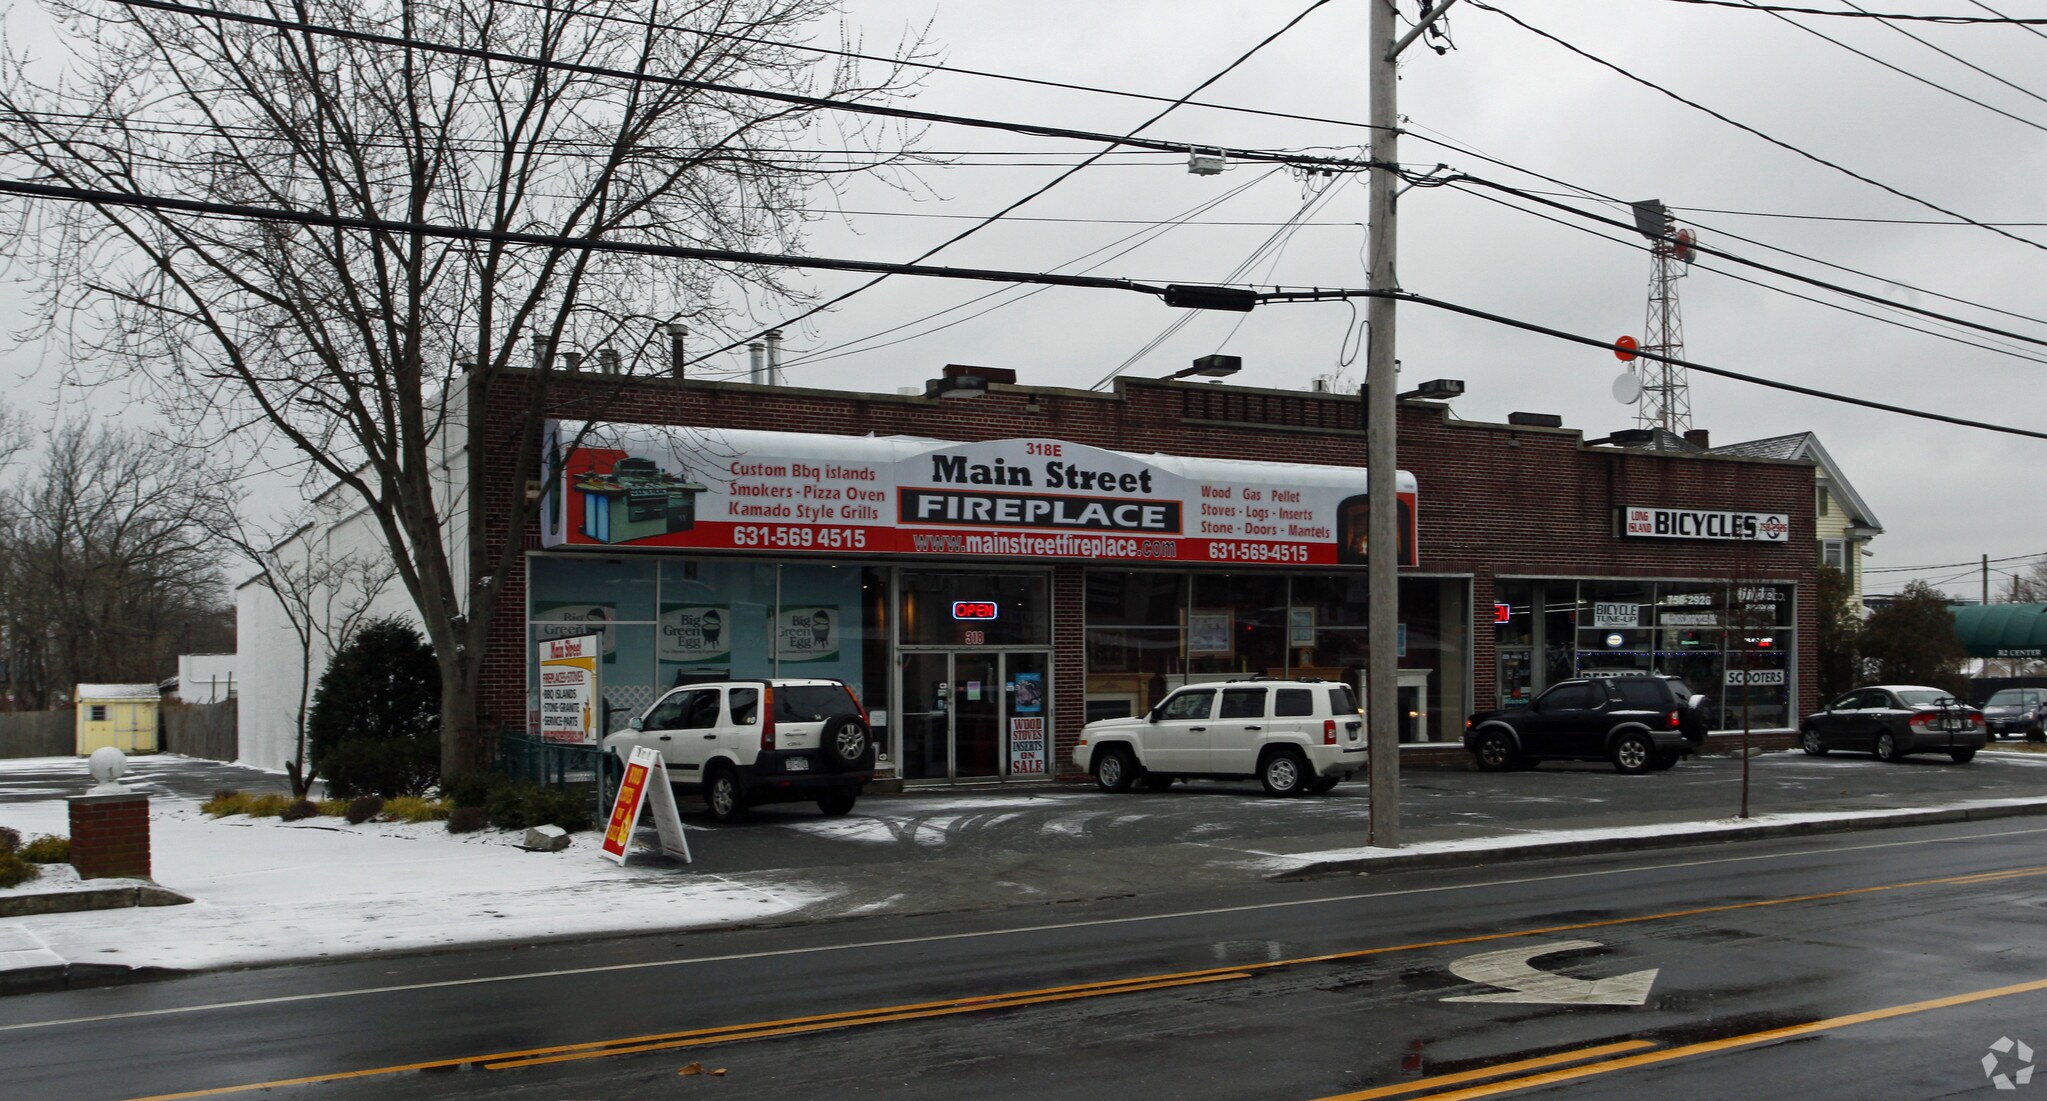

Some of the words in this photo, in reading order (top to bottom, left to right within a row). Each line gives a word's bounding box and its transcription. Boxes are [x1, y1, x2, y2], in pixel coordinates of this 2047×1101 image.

[1026, 442, 1062, 457] 318E
[730, 461, 787, 477] Custom
[792, 463, 820, 482] Bbq
[826, 464, 876, 481] islands
[932, 454, 1032, 486] Main
[1046, 461, 1152, 493] Street
[730, 481, 793, 498] Smokers
[803, 485, 841, 500] Pizza
[846, 487, 885, 502] Oven
[1201, 485, 1231, 499] Wood
[1243, 488, 1262, 501] Gas
[1271, 489, 1301, 503] Pellet
[729, 501, 791, 518] Kamado
[796, 504, 834, 522] Style
[841, 505, 879, 520] Grills
[917, 494, 1166, 529] FIREPLACE
[1201, 503, 1236, 517] Stoves
[1246, 505, 1269, 521] Logs
[1279, 507, 1313, 521] Inserts
[1631, 510, 1649, 522] LONG
[1201, 520, 1233, 534] Stone
[1244, 522, 1277, 535] Doors
[1288, 524, 1331, 539] Mantels
[1628, 522, 1652, 534] ISLAND
[1655, 511, 1757, 538] BICYCLES
[733, 525, 813, 547] 631-569
[817, 528, 866, 548] 4515
[913, 531, 1177, 559] www.mainstreetfireplace.com
[1209, 542, 1308, 562] 631-569-4515
[955, 603, 995, 617] OPEN
[1596, 604, 1637, 616] BICYCLE
[681, 614, 701, 628] Big
[792, 615, 811, 628] Big
[1596, 615, 1637, 623] TUNE-UP
[663, 625, 701, 636] Green
[965, 631, 984, 644] 318
[678, 636, 701, 650] Egg
[790, 636, 811, 649] Egg
[2009, 649, 2042, 657] CENTER
[1728, 671, 1782, 683] SCOOTERS
[555, 688, 577, 699] ISLANDS
[1014, 718, 1042, 730] WOOD
[1013, 730, 1043, 741] STOVES
[1013, 741, 1043, 752] INSERTS
[1020, 752, 1036, 760] ON
[1013, 760, 1043, 774] SALE
